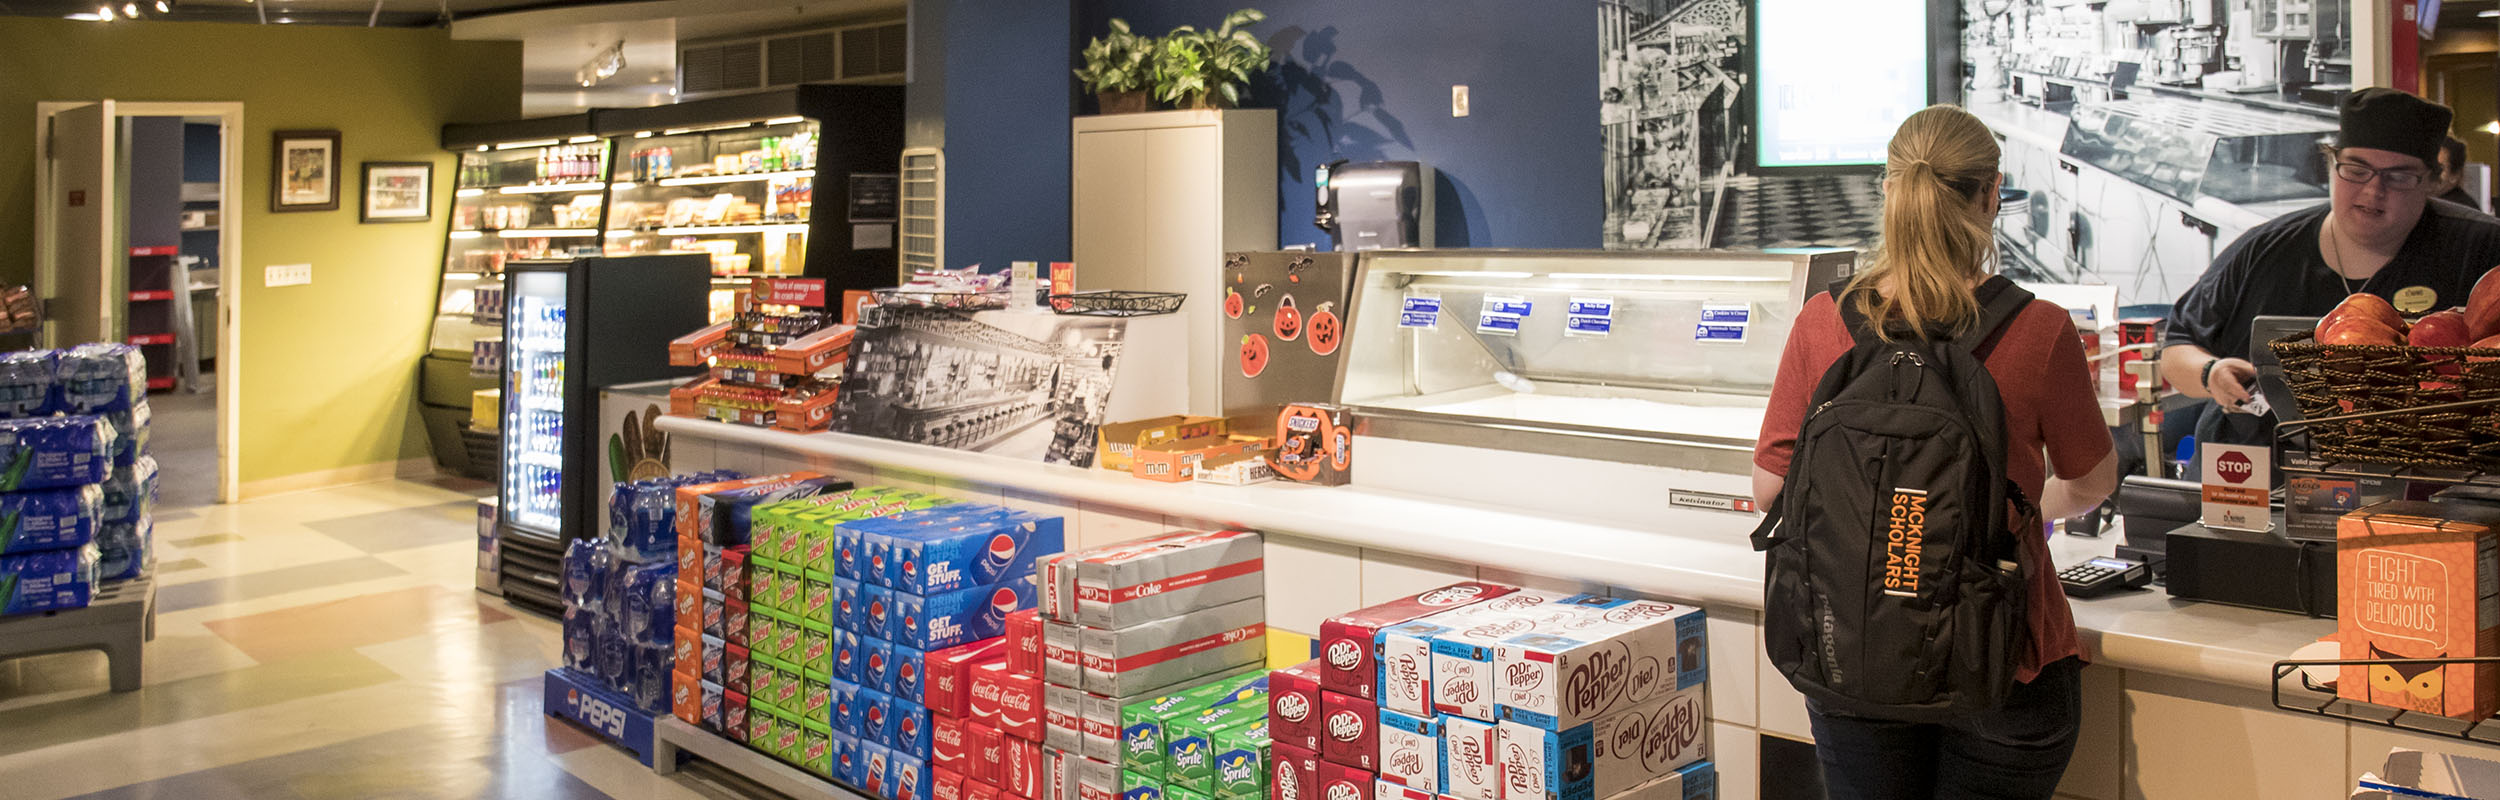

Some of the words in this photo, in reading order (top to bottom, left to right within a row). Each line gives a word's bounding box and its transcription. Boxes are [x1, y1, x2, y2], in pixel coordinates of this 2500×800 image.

[810, 352, 824, 366] G
[811, 407, 824, 420] G
[1289, 416, 1319, 430] SNICKERS
[2218, 460, 2251, 474] STOP
[1885, 493, 1908, 588] SCHOLARS
[1903, 495, 1927, 591] MCKNIGHT
[927, 561, 950, 576] GET
[2368, 554, 2421, 584] FIGHT
[928, 569, 962, 587] STUFF.
[1080, 587, 1099, 600] Coke
[1136, 583, 1162, 597] Coke
[2367, 580, 2398, 600] TIRED
[2403, 584, 2435, 603] WITH
[928, 616, 952, 630] GET
[2366, 600, 2439, 633] DELICIOUS.
[929, 624, 963, 641] STUFF.
[1223, 628, 1247, 641] Coke
[1046, 646, 1065, 661] Coke
[1340, 639, 1352, 654] Dr
[1419, 646, 1428, 657] 12
[1497, 648, 1506, 657] 12
[1083, 655, 1103, 670] Coke
[1328, 643, 1359, 670] Pepper
[1560, 655, 1568, 666] 12
[1519, 662, 1531, 675] Dr
[1588, 649, 1612, 683] Dr
[1400, 657, 1416, 698] Pepper
[1411, 669, 1420, 688] Dr
[1507, 664, 1541, 687] Pepper
[1632, 667, 1654, 697] Diet
[1360, 684, 1369, 693] 12
[1445, 680, 1476, 703] Pepper
[1570, 655, 1627, 717] Pepper
[1150, 696, 1186, 713] Sprite
[1289, 695, 1299, 707] Dr
[1454, 693, 1467, 704] Dr
[1514, 693, 1526, 701] Diet
[1278, 696, 1307, 719] Pepper
[1480, 708, 1489, 719] 12
[579, 693, 627, 739] PEPSI
[1047, 711, 1066, 726] Coke
[1196, 708, 1233, 724] Sprite
[1341, 713, 1353, 725] Dr
[1084, 721, 1103, 735] Coke
[1332, 715, 1360, 738] Pepper
[1500, 728, 1508, 739] 12
[1646, 697, 1693, 759] Pepper
[1308, 736, 1316, 745] 12
[1619, 719, 1640, 750] Diet
[1130, 736, 1155, 754] Sprite
[1659, 736, 1681, 763] Dr
[1176, 748, 1202, 768] Sprite
[1361, 755, 1370, 765] 12
[1392, 751, 1421, 774] Pepper
[1463, 736, 1480, 782] Pepper
[1475, 753, 1483, 771] Dr
[1508, 757, 1519, 773] Dr
[1223, 763, 1251, 783] Sprite
[1400, 764, 1412, 776] Dr
[1511, 747, 1528, 790] Pepper
[1339, 784, 1351, 796] Dr
[1380, 784, 1387, 793] 12
[1424, 780, 1432, 790] 12
[1484, 788, 1492, 800] 12
